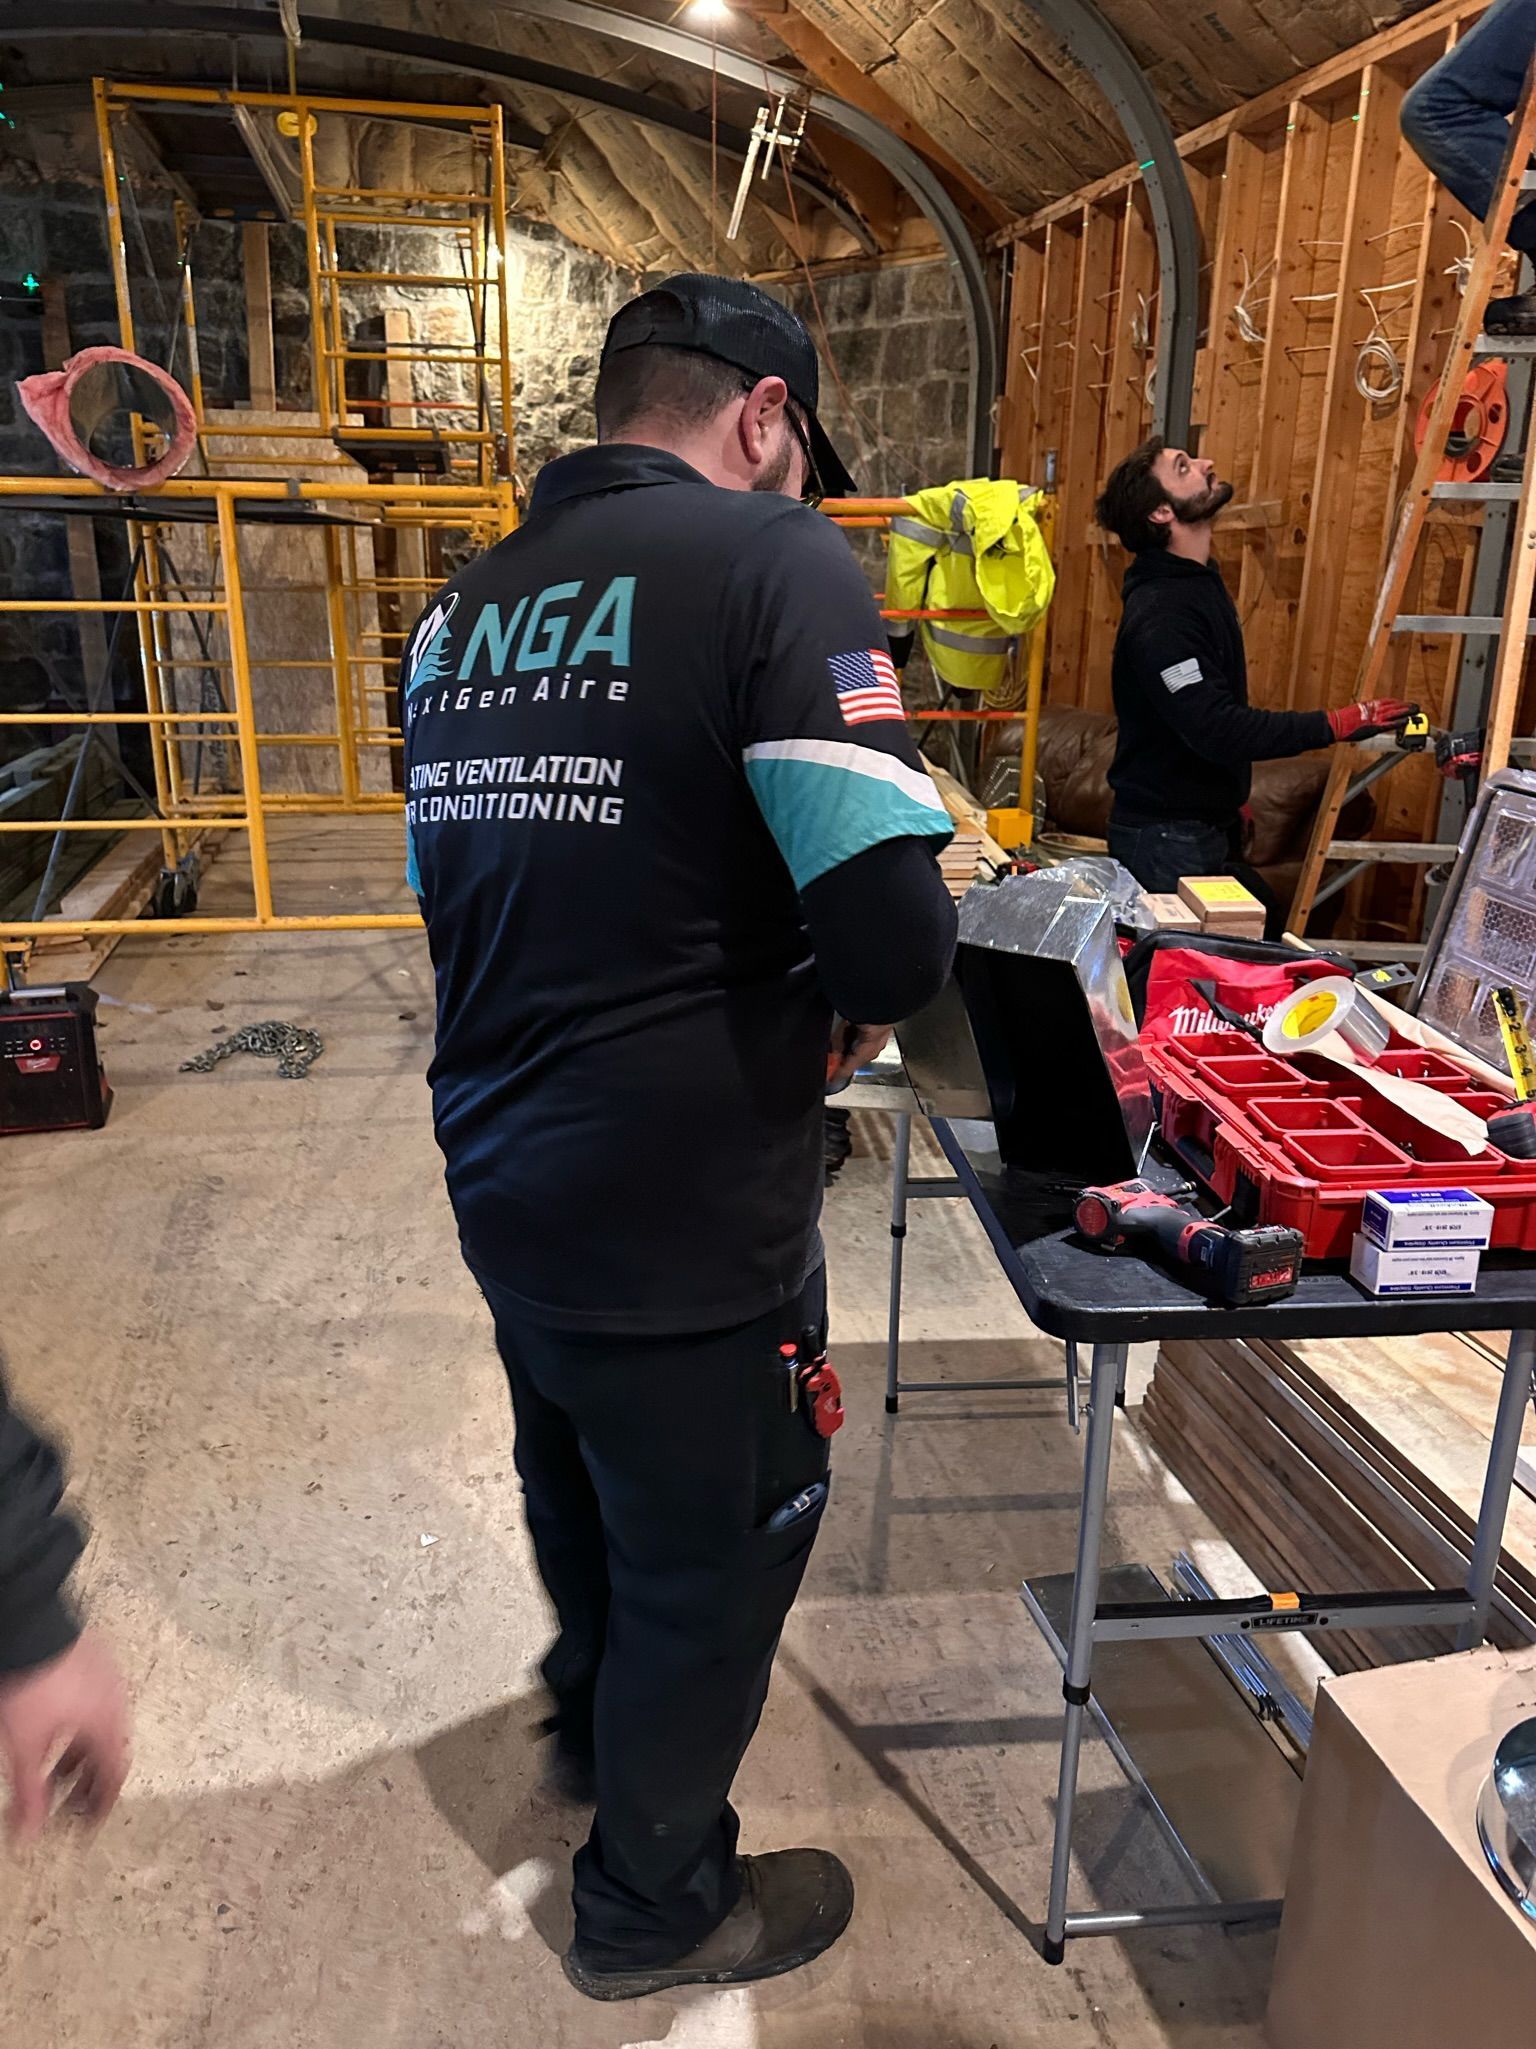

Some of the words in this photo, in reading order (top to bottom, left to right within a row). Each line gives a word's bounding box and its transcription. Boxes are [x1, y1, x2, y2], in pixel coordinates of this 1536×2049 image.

[457, 576, 637, 681] NGA
[532, 672, 630, 702] Aire
[455, 756, 624, 788] VENTILATION
[420, 793, 625, 825] CONDITIONING
[1509, 1022, 1521, 1032] 2
[1514, 1044, 1527, 1053] 3
[1520, 1066, 1533, 1077] 4
[1259, 1616, 1309, 1626] LIFETIME
